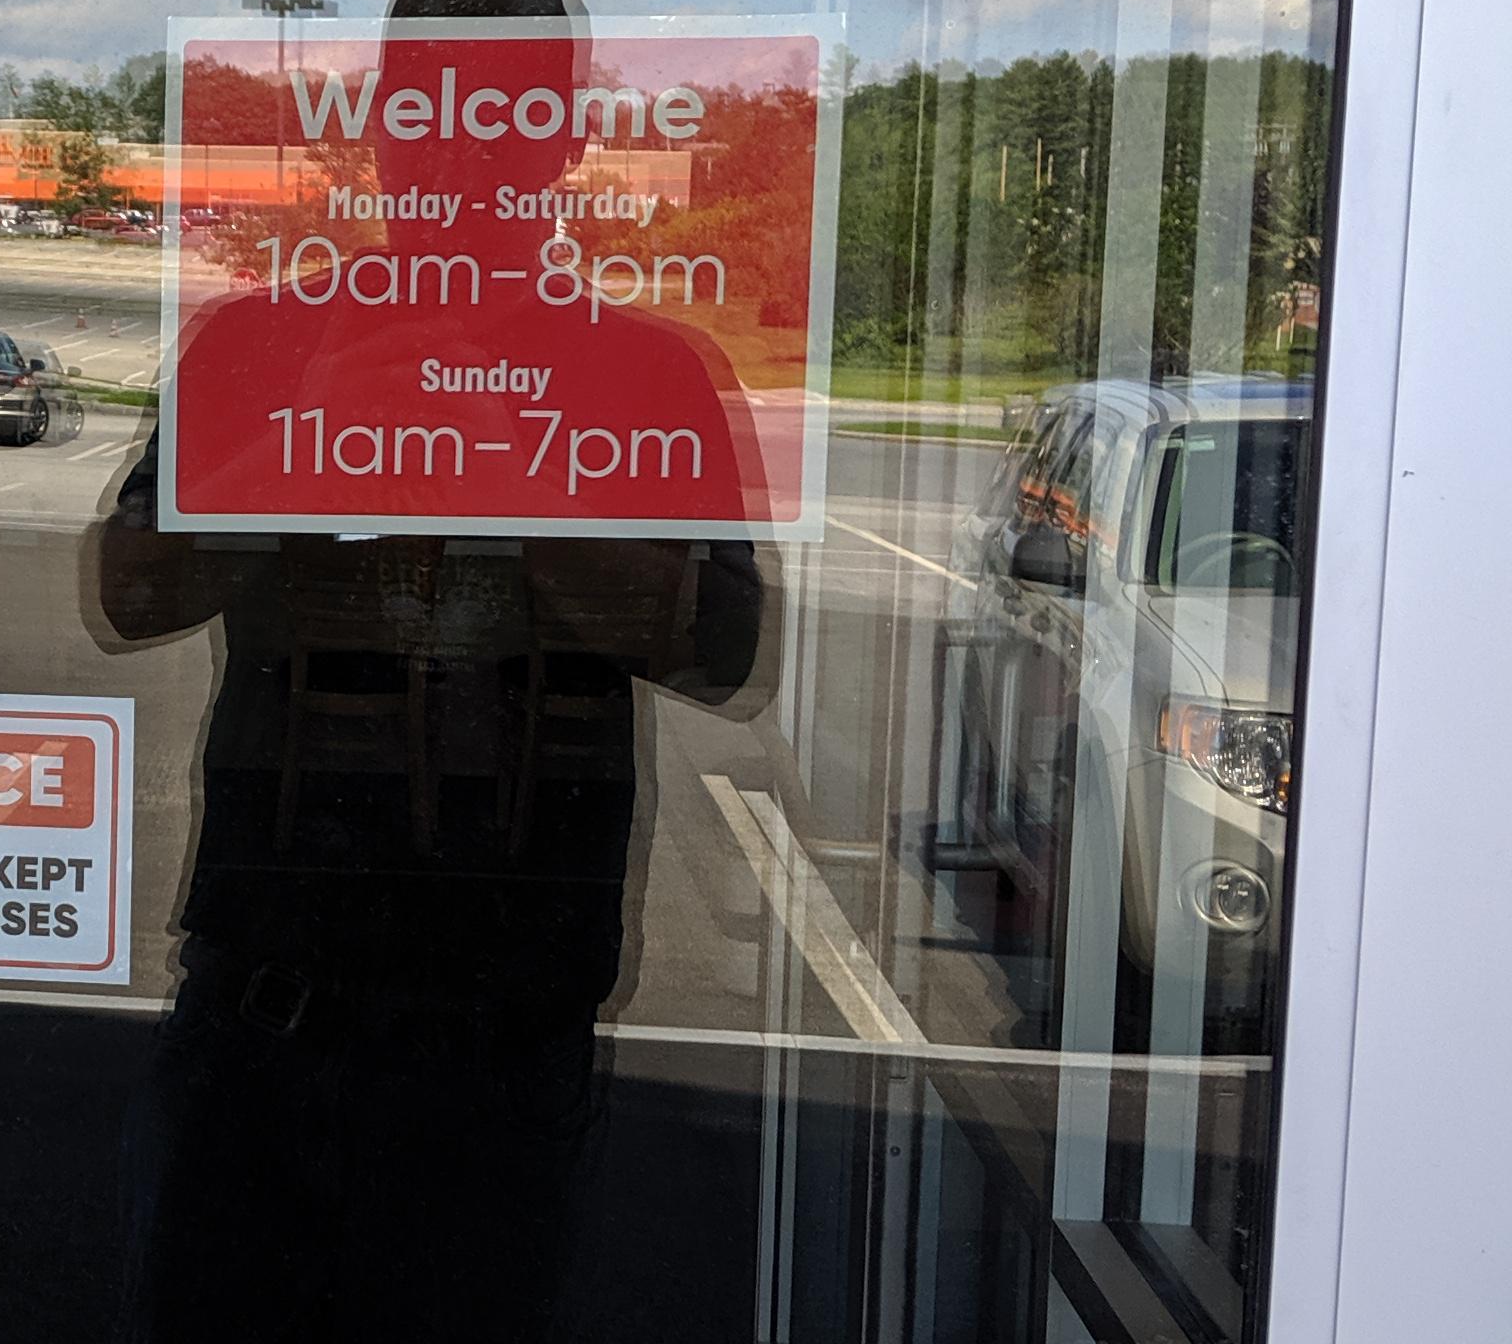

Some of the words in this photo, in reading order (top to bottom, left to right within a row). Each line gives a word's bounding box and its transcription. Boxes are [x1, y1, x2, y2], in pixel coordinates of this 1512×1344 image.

[290, 66, 705, 141] Welcome
[327, 185, 463, 227] Monday
[495, 185, 658, 228] Saturday
[419, 358, 553, 402] Sunday
